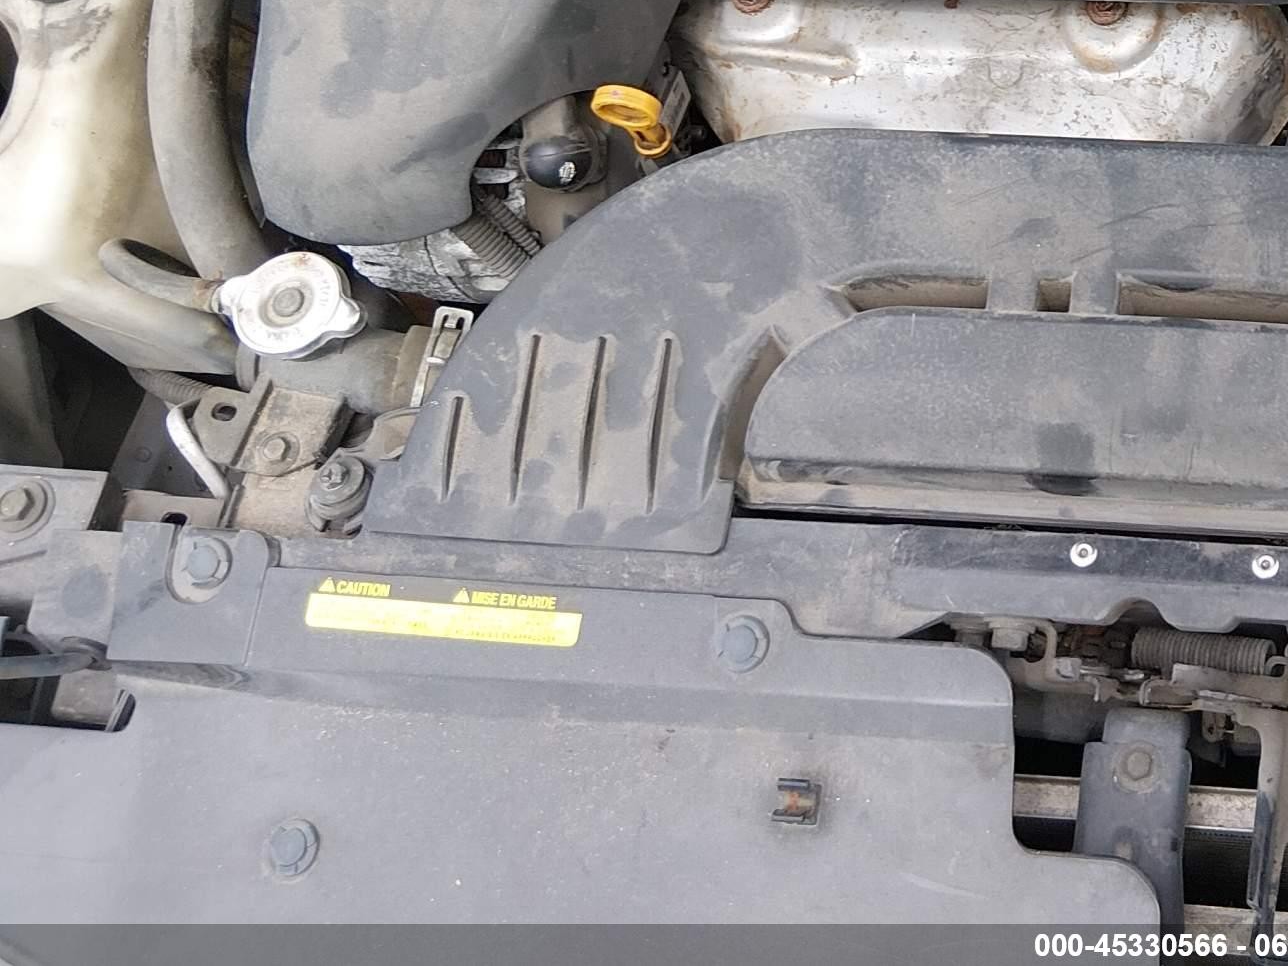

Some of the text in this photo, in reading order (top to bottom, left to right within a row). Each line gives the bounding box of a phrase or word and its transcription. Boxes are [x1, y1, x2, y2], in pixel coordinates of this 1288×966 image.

[336, 580, 392, 597] CAUTION
[471, 590, 557, 611] MISE EN GARDE
